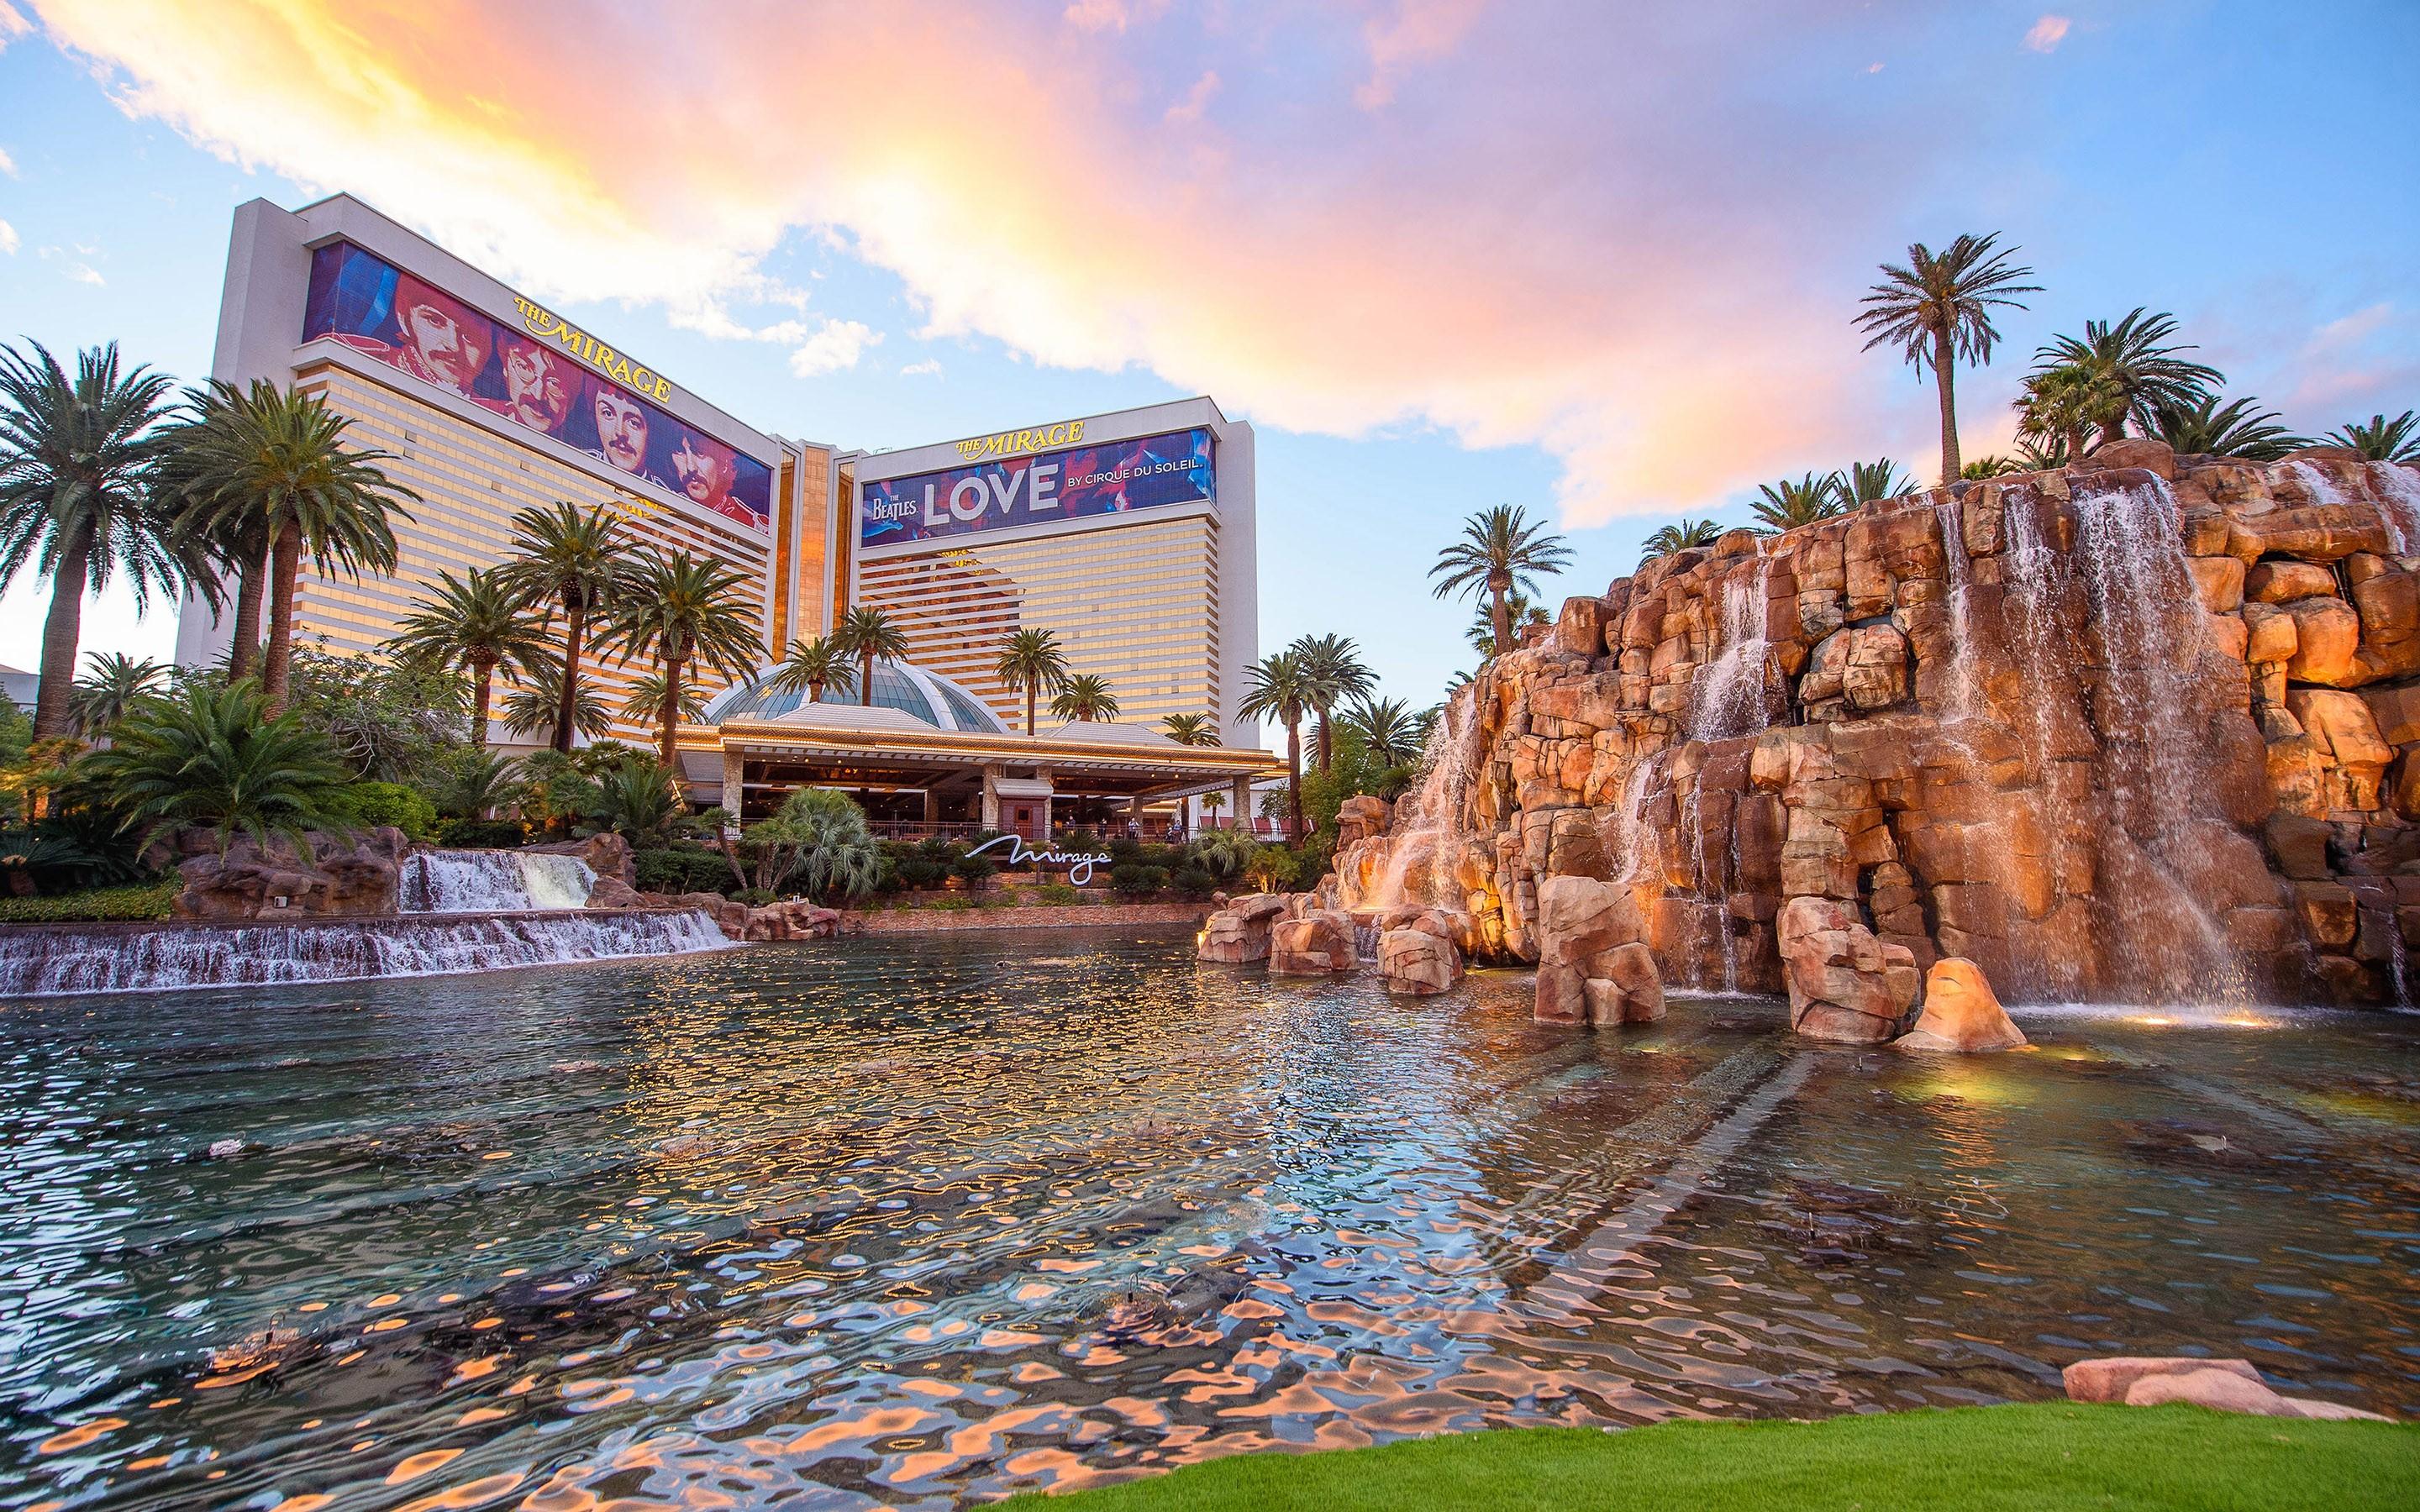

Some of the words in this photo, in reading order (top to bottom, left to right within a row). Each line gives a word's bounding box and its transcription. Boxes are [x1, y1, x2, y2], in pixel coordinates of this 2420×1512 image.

[513, 297, 552, 328] THE
[524, 320, 671, 403] MIRAGE
[955, 438, 982, 454] THE
[964, 421, 1085, 460] MIRAGE
[924, 464, 1059, 526] LOVE
[1068, 476, 1083, 487] BY
[1085, 469, 1130, 484] CIRQUE
[1134, 465, 1152, 477] DU
[965, 834, 1112, 885] Mirage
